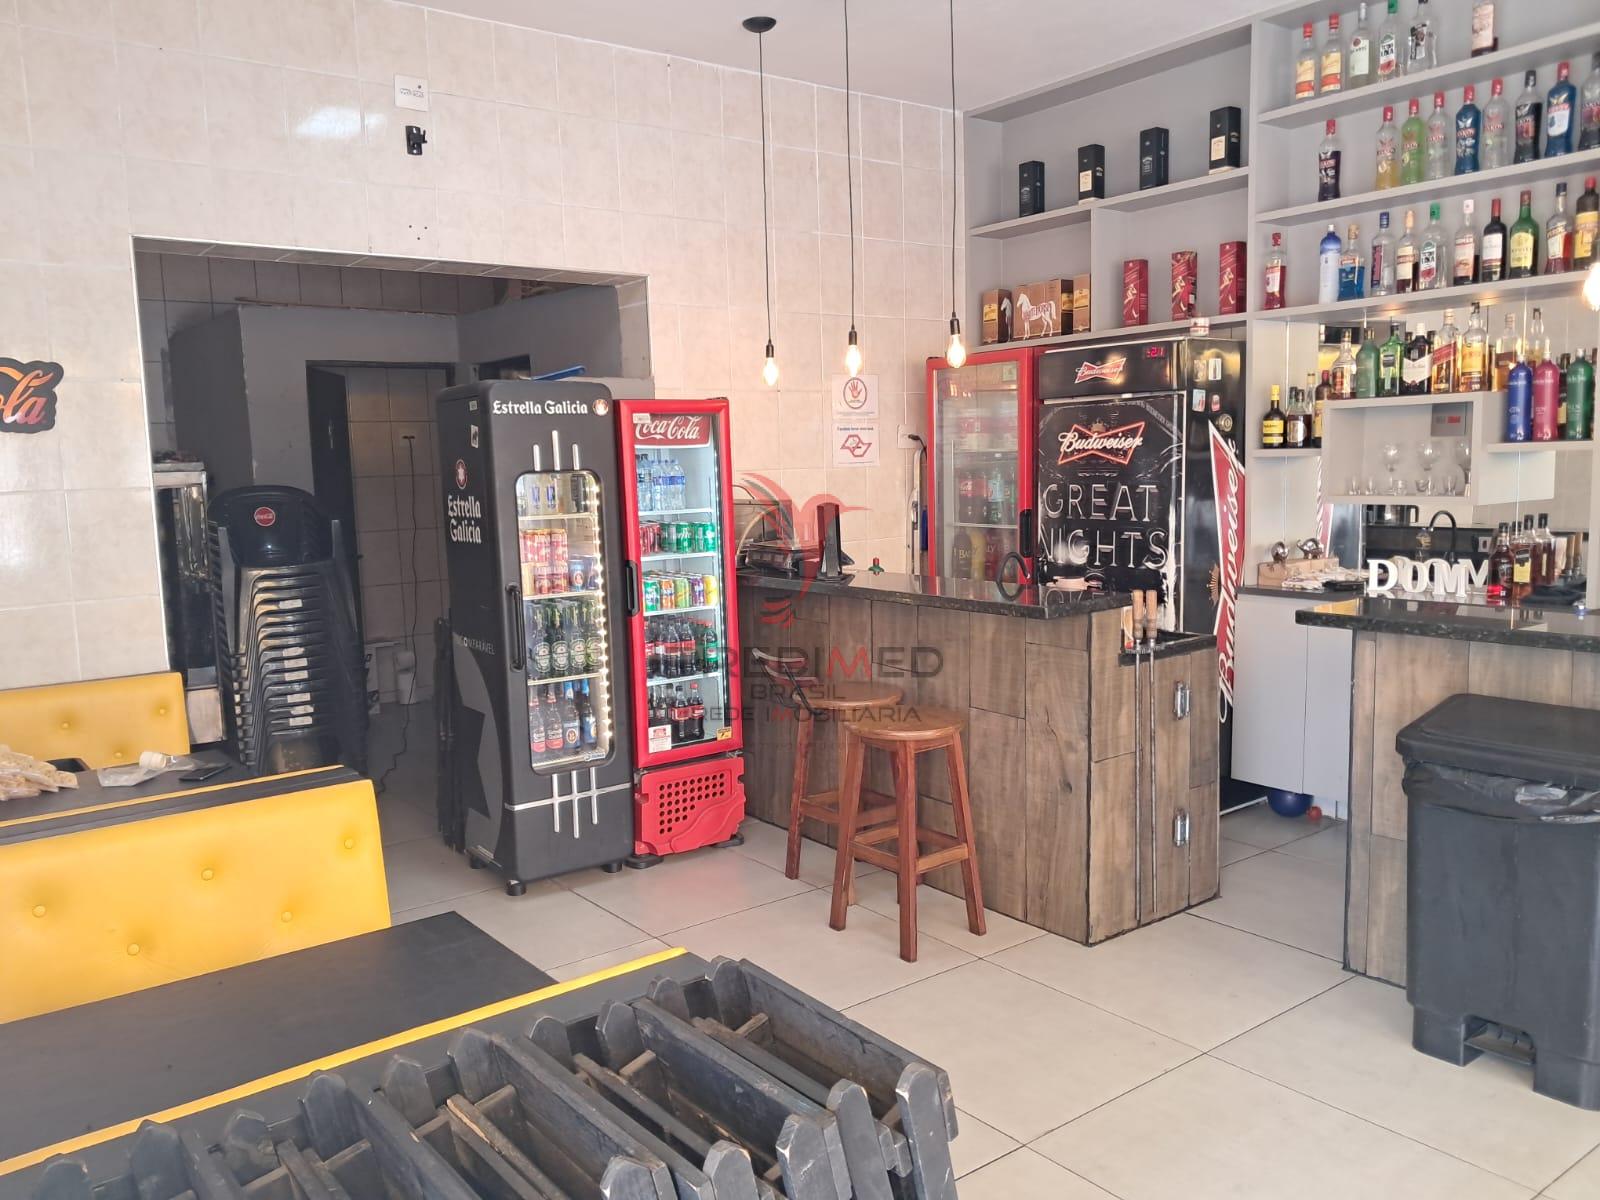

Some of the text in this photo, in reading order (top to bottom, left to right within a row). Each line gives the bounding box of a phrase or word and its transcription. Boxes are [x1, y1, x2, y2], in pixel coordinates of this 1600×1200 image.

[493, 400, 588, 415] Estrella Galicia
[1058, 431, 1143, 453] Budweiser
[447, 495, 482, 518] Estrella
[1043, 483, 1159, 522] GREAT
[450, 518, 482, 544] Galicia
[1039, 524, 1168, 569] NIGHTS
[1367, 559, 1467, 598] DOM
